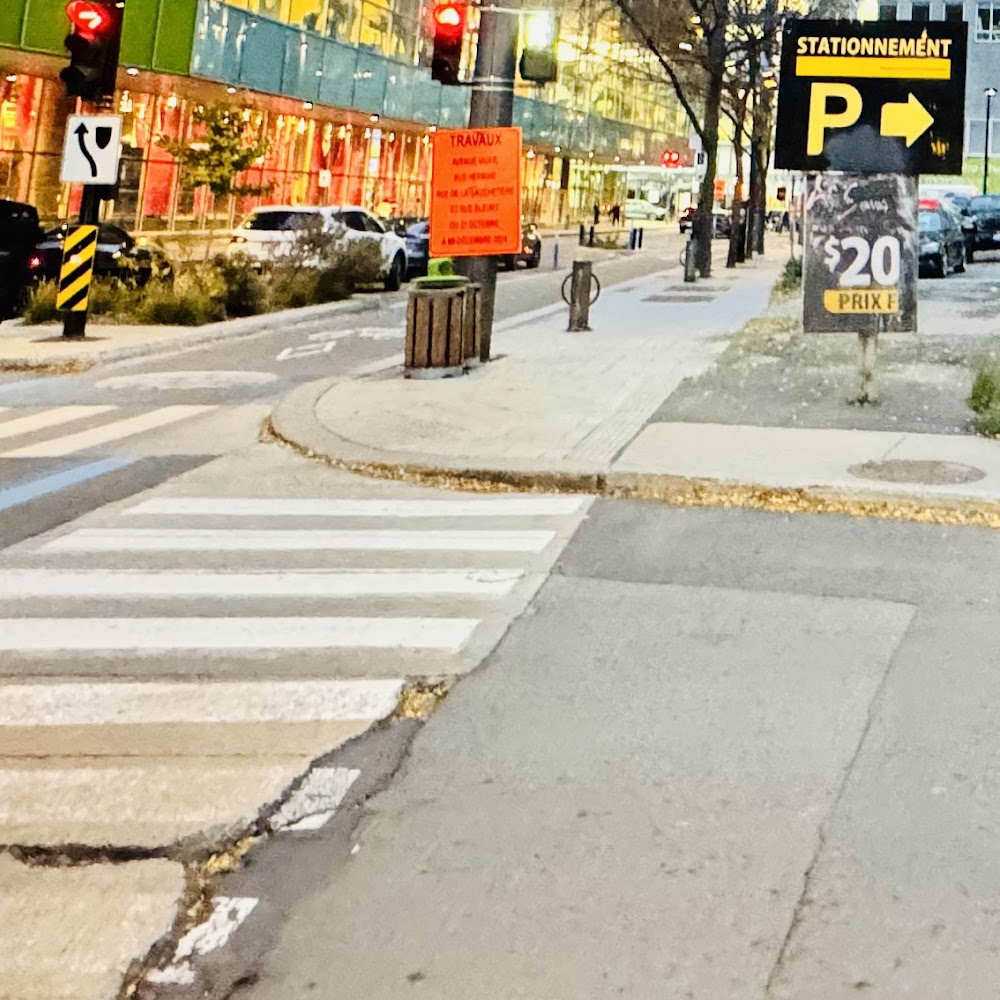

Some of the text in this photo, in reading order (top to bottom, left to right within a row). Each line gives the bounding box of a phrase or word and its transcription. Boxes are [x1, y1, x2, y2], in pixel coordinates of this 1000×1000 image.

[806, 81, 863, 156] P
[450, 132, 502, 148] TRAVAUX
[824, 235, 900, 286] $20
[838, 293, 881, 311] PRIX
